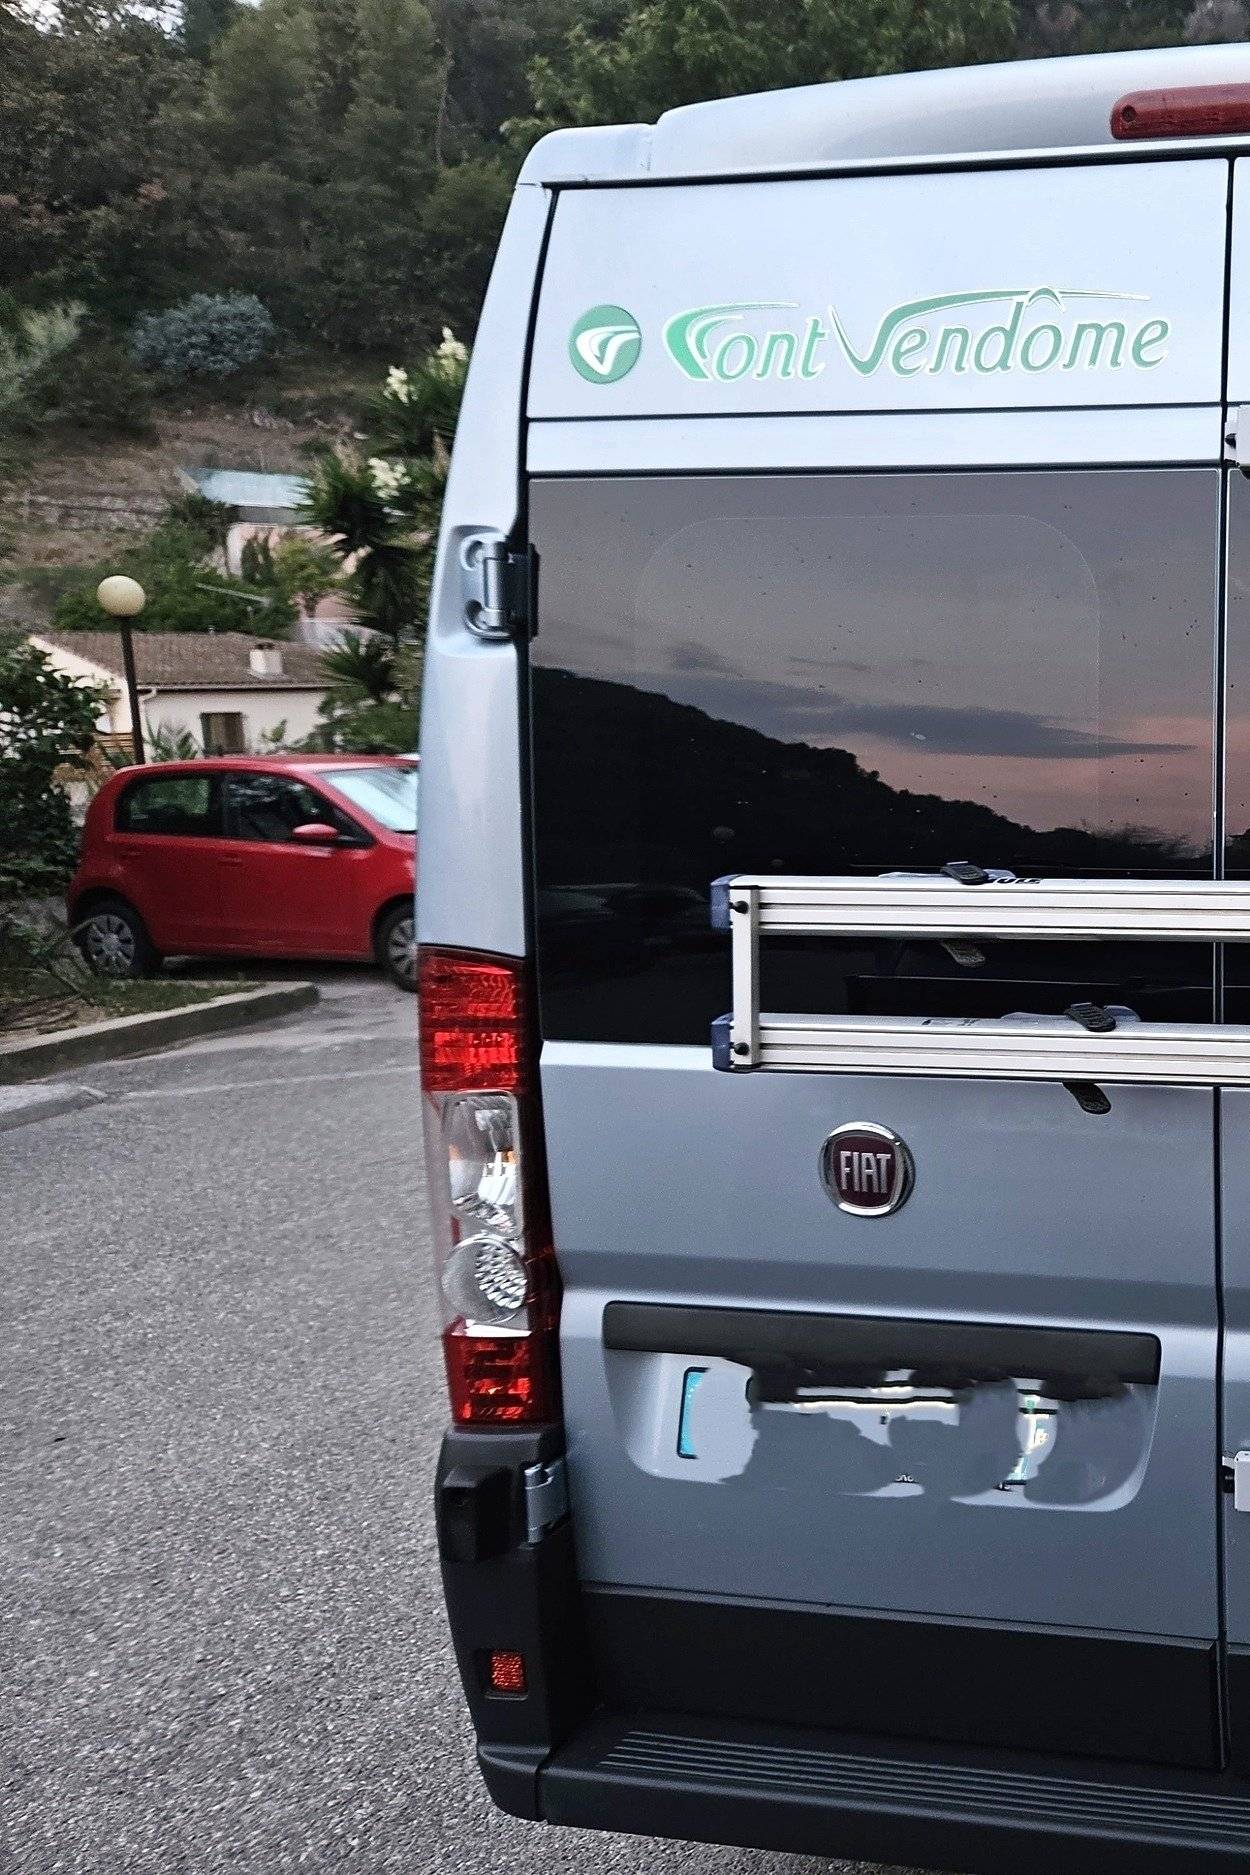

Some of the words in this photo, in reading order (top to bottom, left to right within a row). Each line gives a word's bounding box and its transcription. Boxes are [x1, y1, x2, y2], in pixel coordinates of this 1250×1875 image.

[663, 301, 828, 381] Font
[829, 286, 1171, 377] Vendôme
[840, 1150, 892, 1194] FIAT
